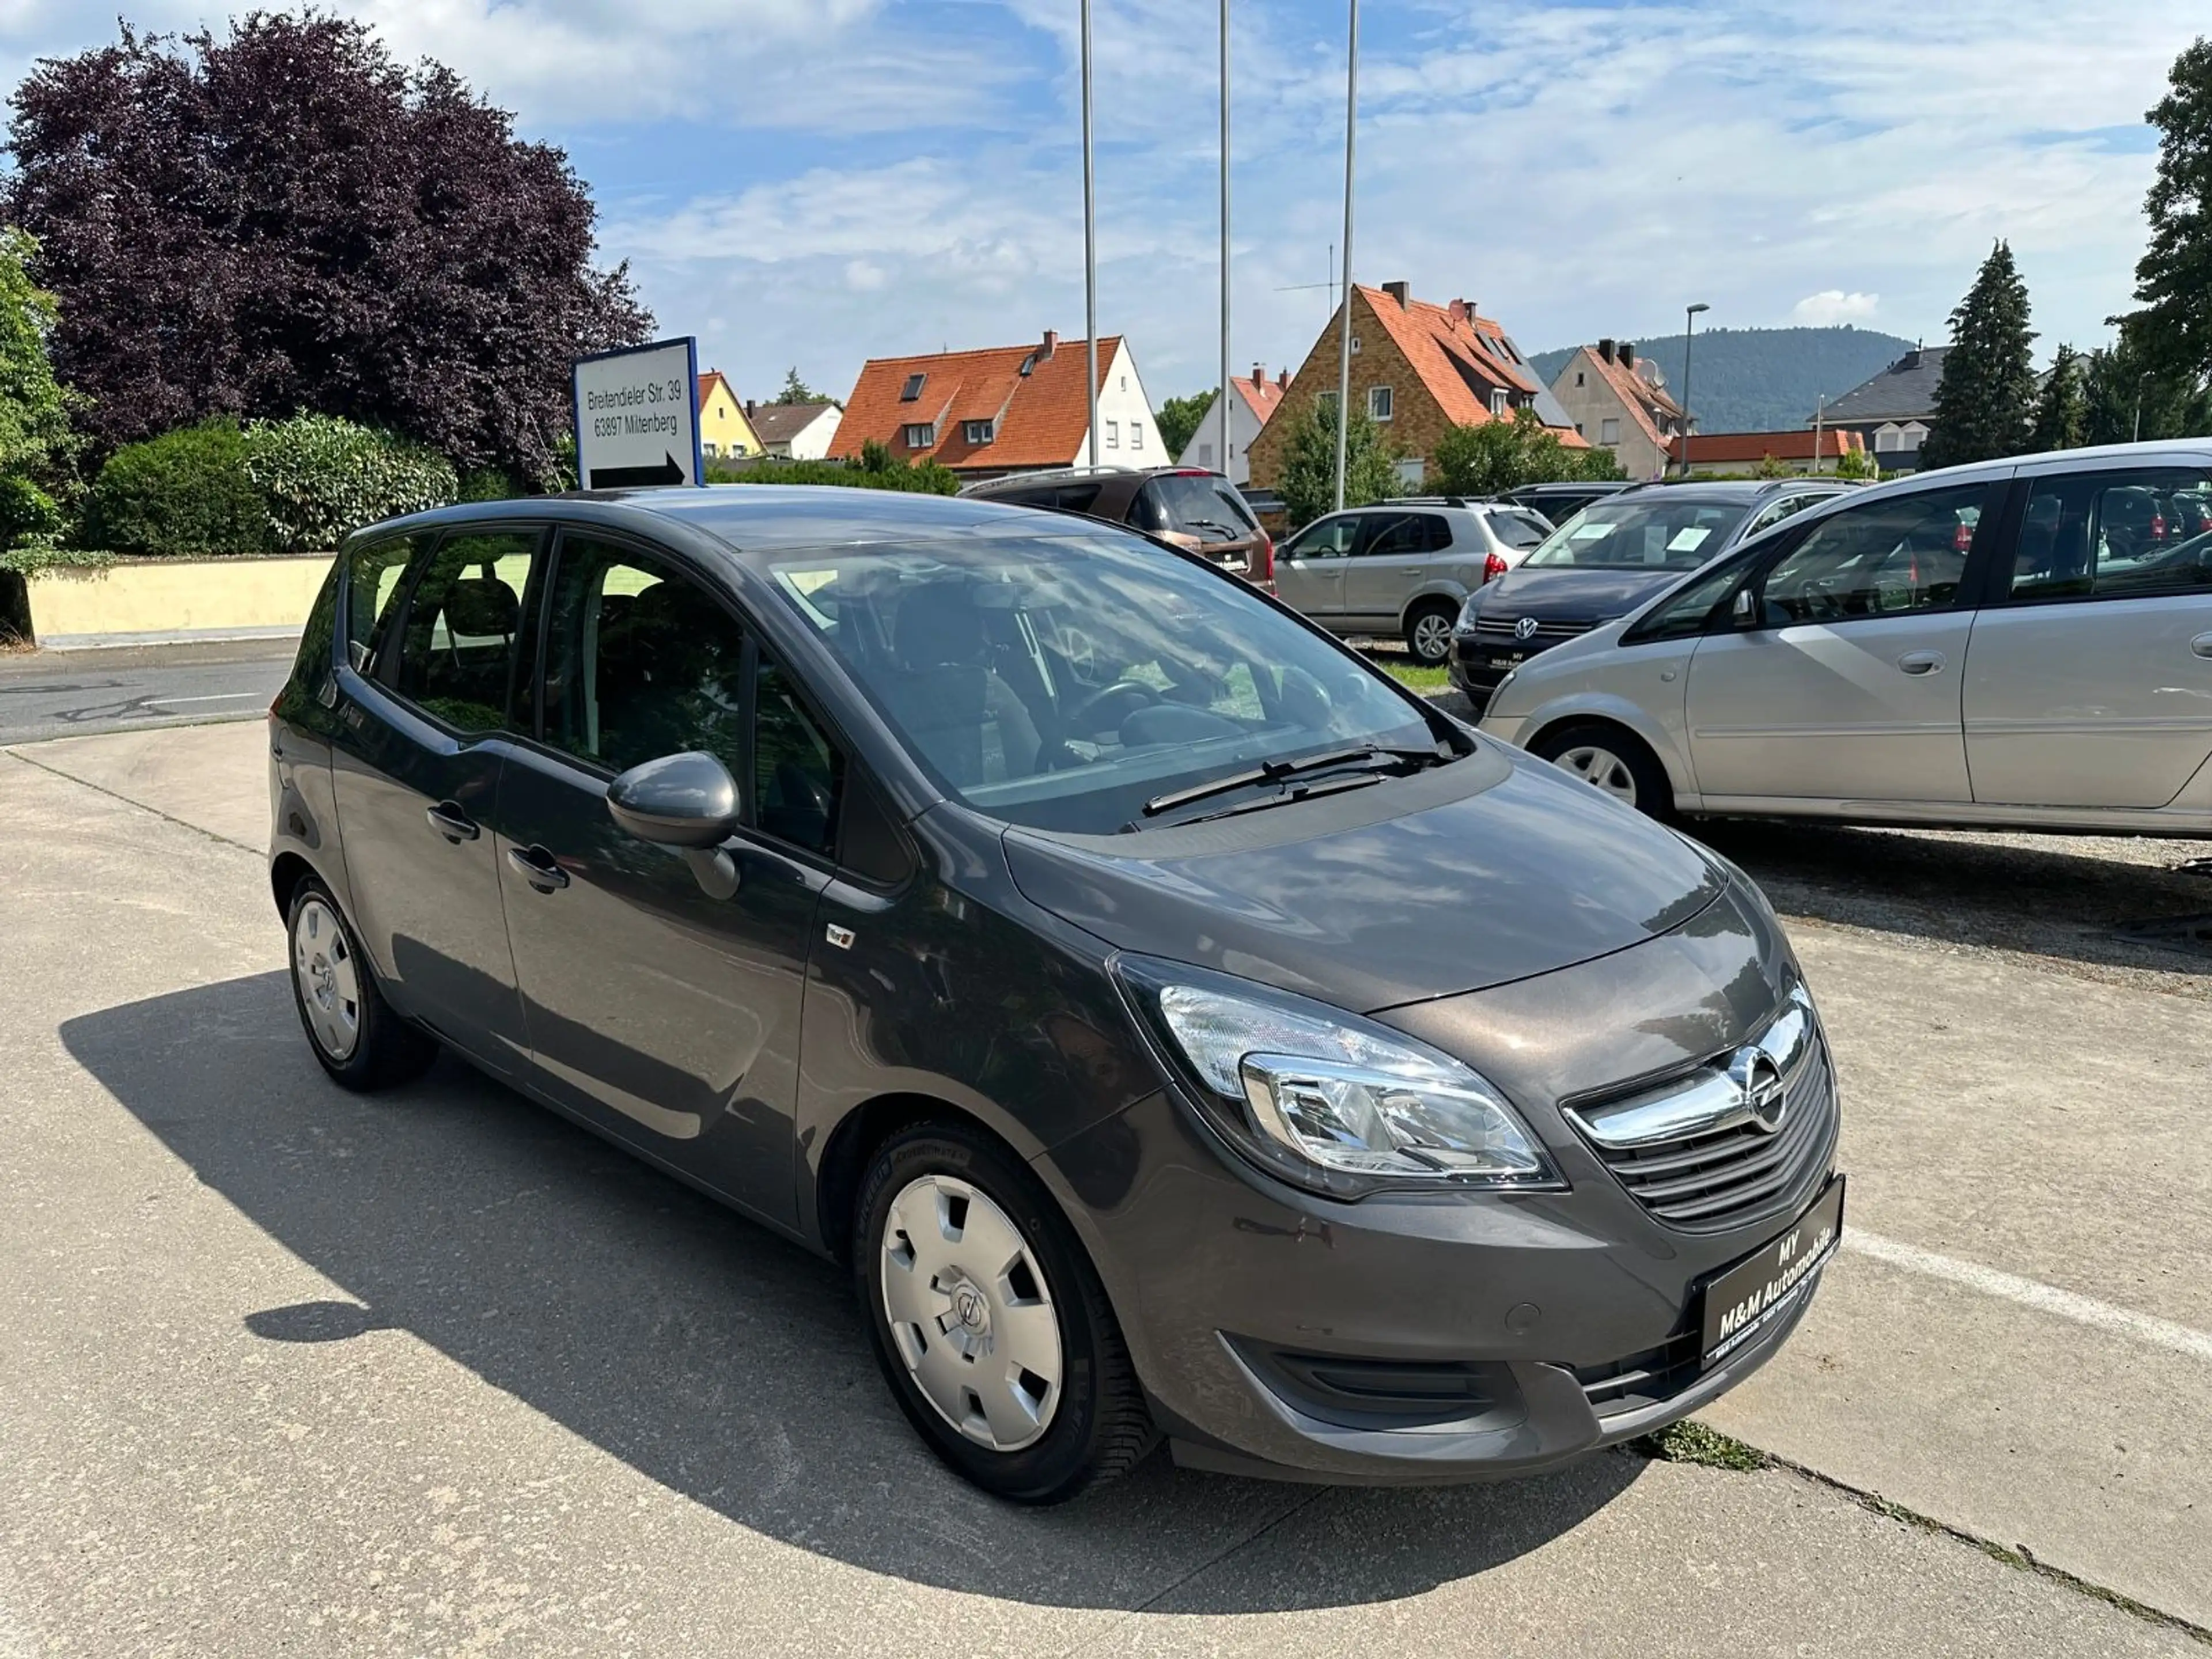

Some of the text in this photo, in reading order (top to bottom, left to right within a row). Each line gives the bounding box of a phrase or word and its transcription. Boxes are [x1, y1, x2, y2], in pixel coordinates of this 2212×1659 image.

[648, 382, 665, 403] Str.
[668, 379, 681, 402] 39
[594, 412, 677, 437] 63897 Miltenberg
[1778, 1229, 1801, 1267] MY
[1719, 1289, 1761, 1340] M&M
[1763, 1227, 1831, 1308] Automobile
